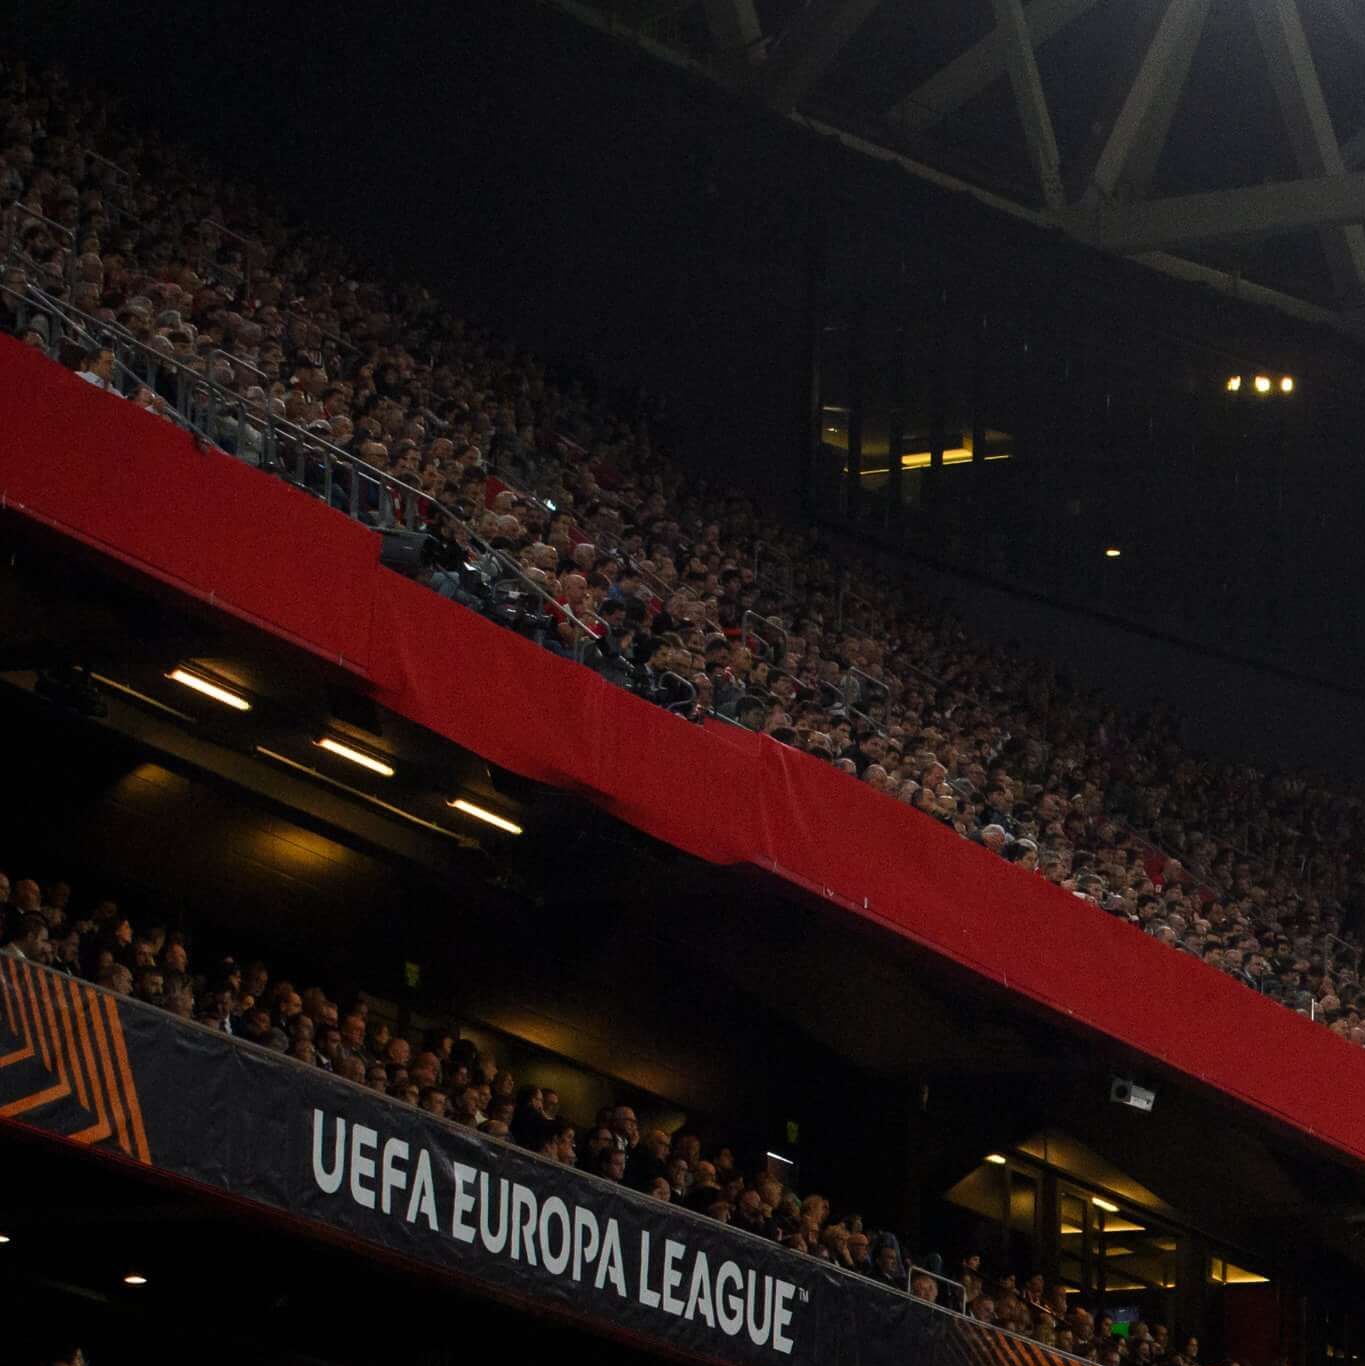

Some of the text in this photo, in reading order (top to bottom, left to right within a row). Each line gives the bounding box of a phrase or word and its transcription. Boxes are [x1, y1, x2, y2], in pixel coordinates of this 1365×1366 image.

[312, 1108, 439, 1232] UEFA
[452, 1161, 628, 1298] EUROPA
[639, 1230, 796, 1355] LEAGUE
